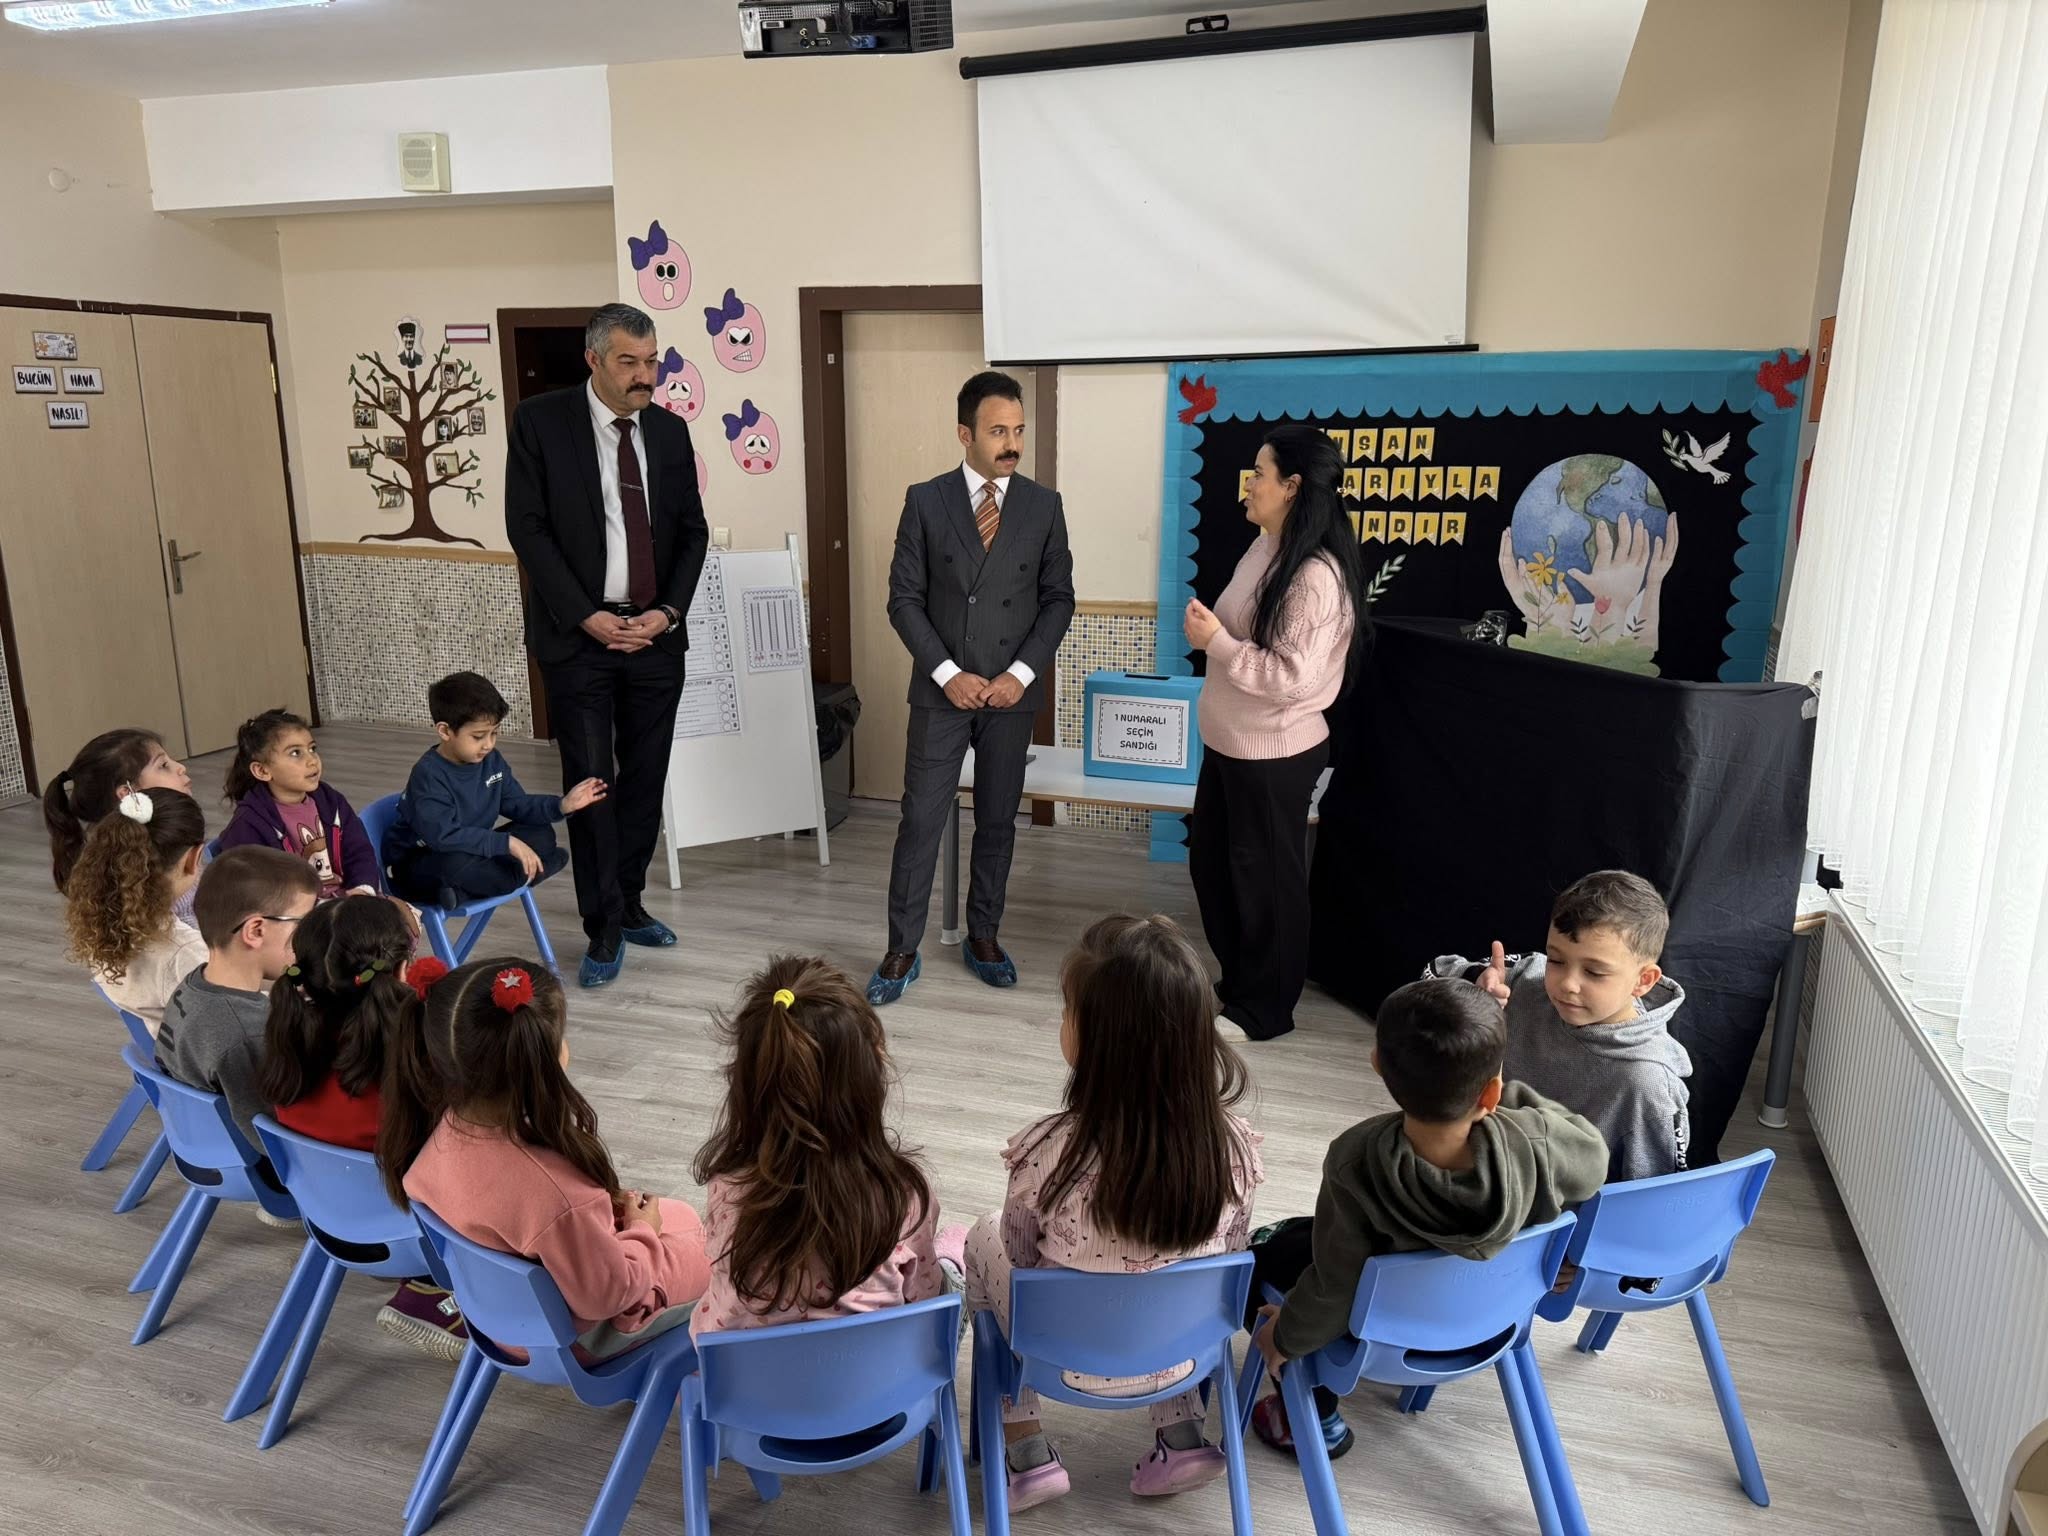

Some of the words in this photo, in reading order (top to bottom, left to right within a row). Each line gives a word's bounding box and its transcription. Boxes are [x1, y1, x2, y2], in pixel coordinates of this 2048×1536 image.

[70, 374, 95, 388] HAVA
[51, 407, 83, 420] NASIL?
[1333, 434, 1428, 451] NSAN
[1345, 473, 1492, 490] ARIYLA
[1368, 517, 1459, 535] NDIR
[1114, 713, 1119, 721] 1
[1120, 714, 1167, 725] NUMARALI
[1126, 727, 1154, 738] SEÇİM
[1120, 740, 1158, 751] SANDIĞI
